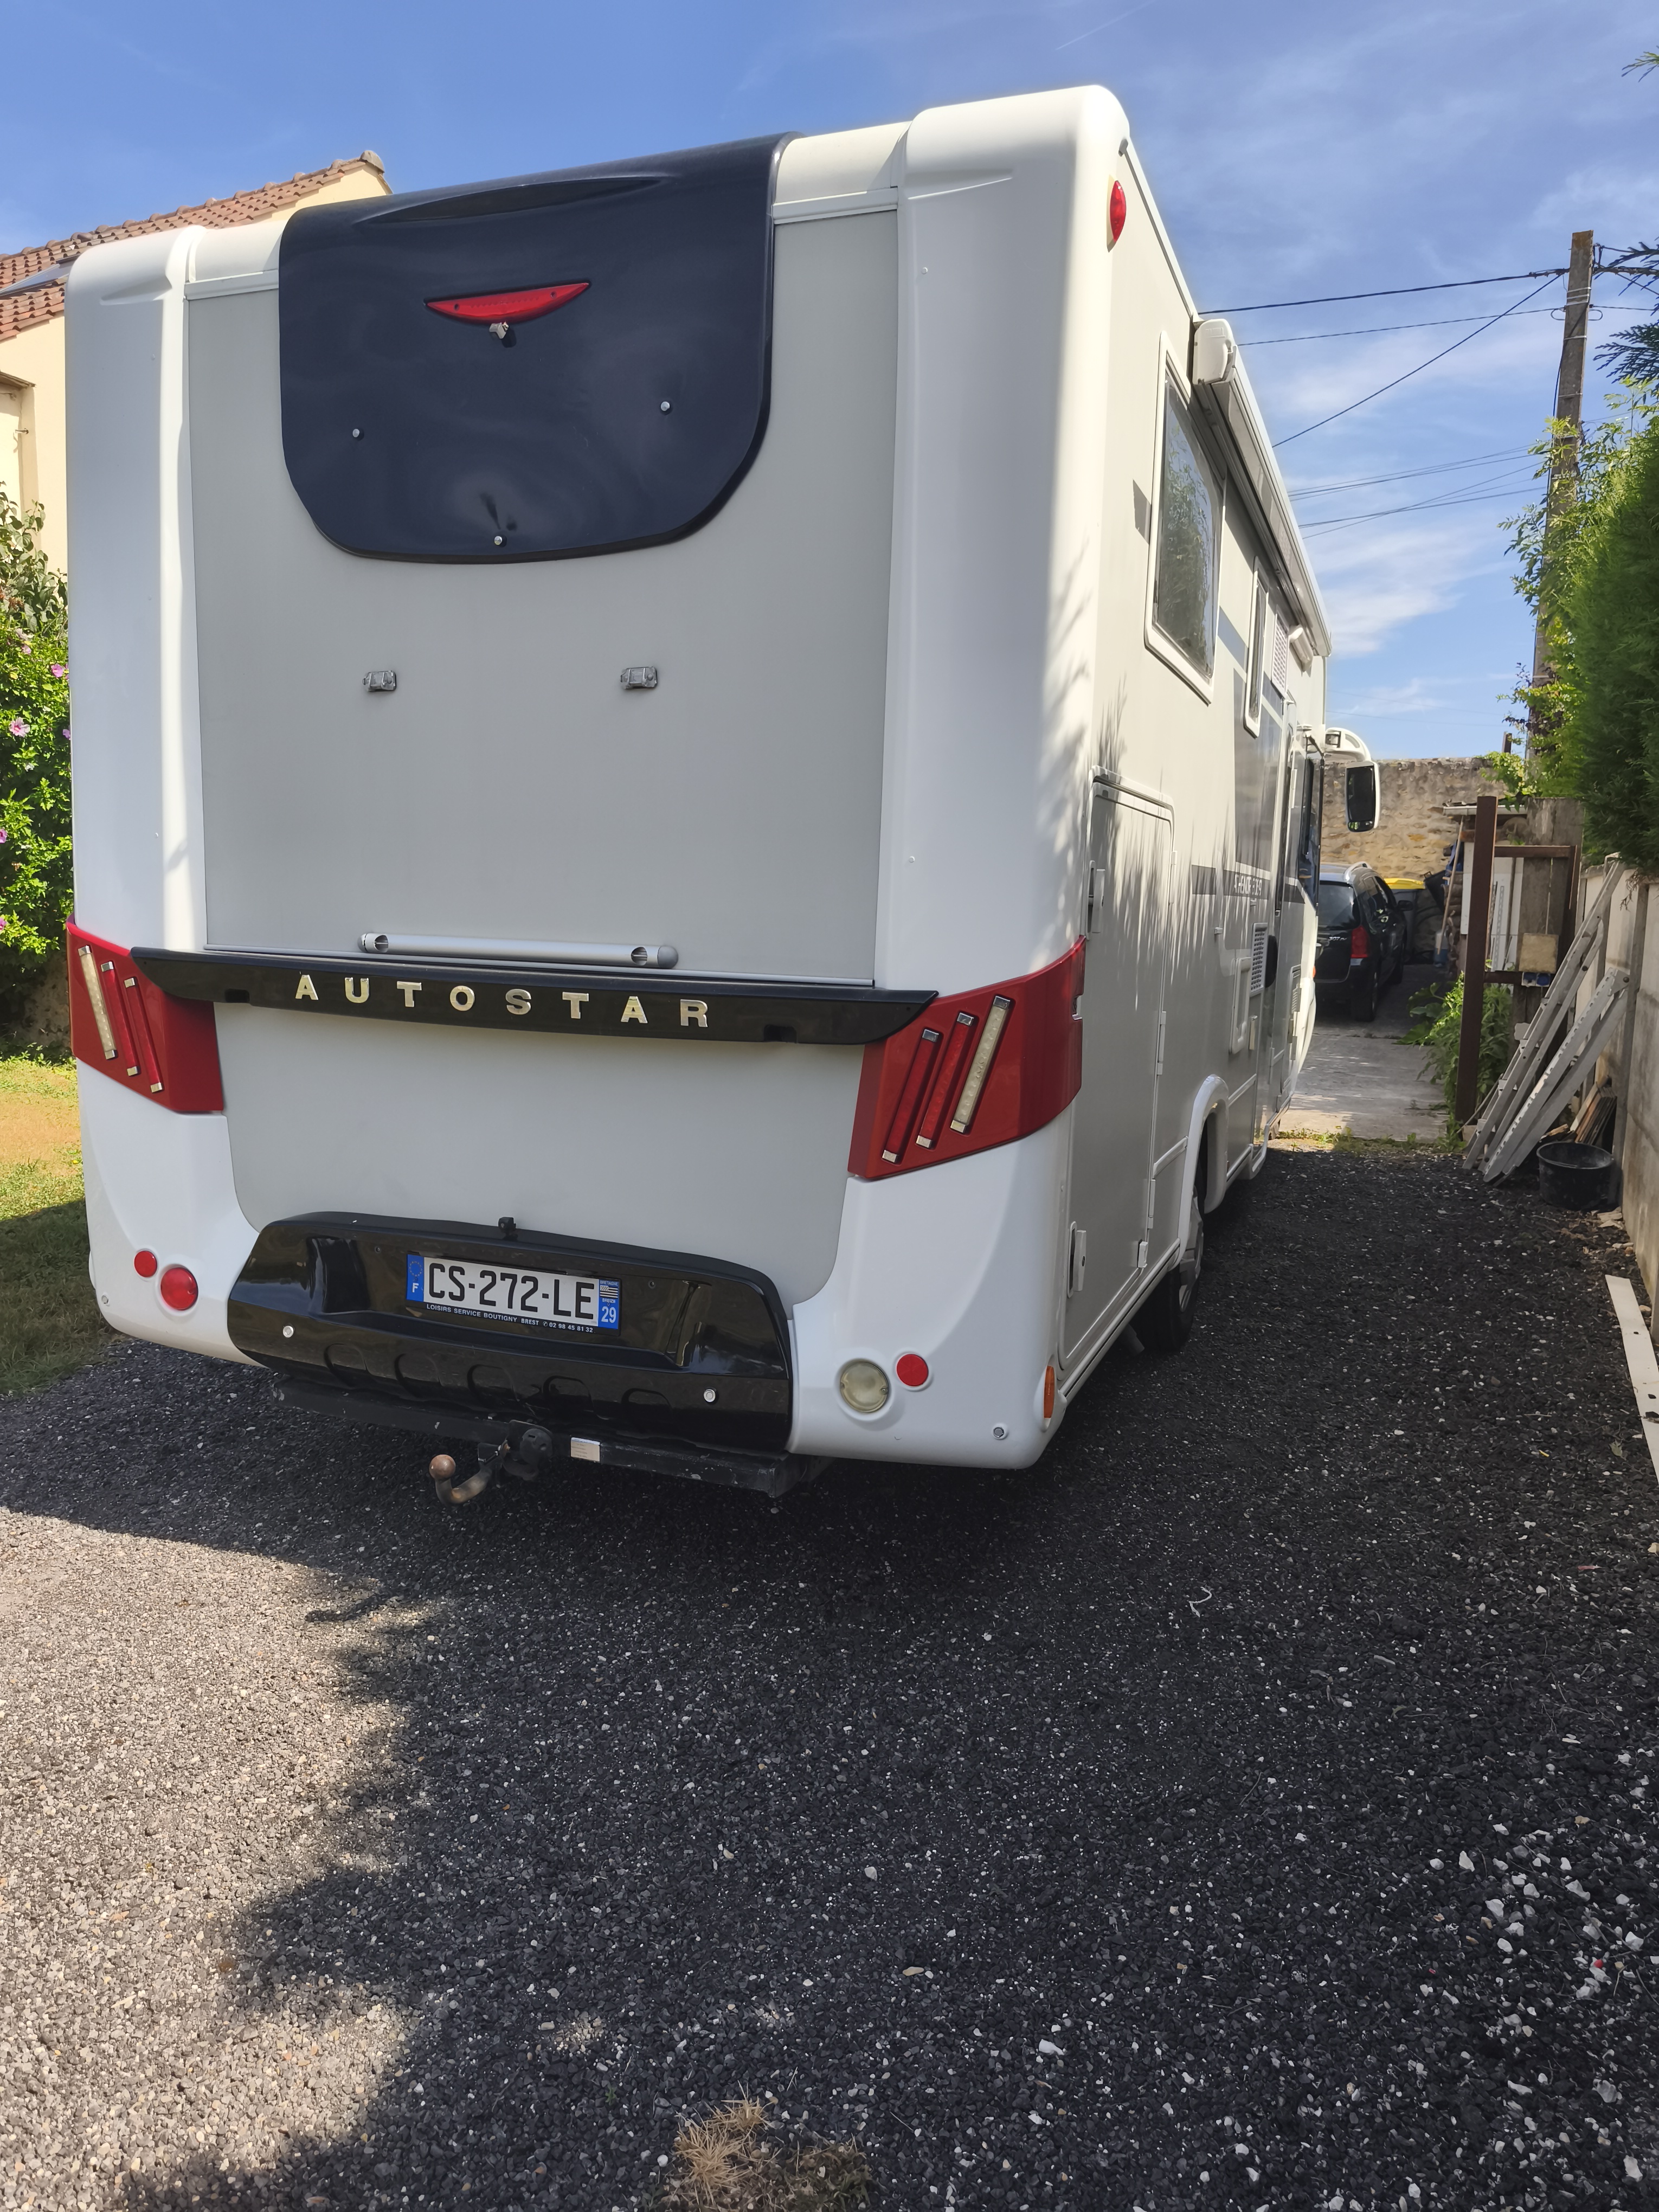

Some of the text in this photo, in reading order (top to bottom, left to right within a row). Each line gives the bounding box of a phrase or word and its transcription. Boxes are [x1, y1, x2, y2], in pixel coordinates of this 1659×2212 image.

[295, 974, 709, 1027] AUTOSTAR
[412, 1282, 419, 1293] F
[429, 1263, 595, 1320] CS-272-LE
[427, 1304, 452, 1313] LOISIRS
[454, 1308, 481, 1317] SERVICE
[484, 1313, 517, 1322] BOUTIGNY
[601, 1306, 616, 1323] 29
